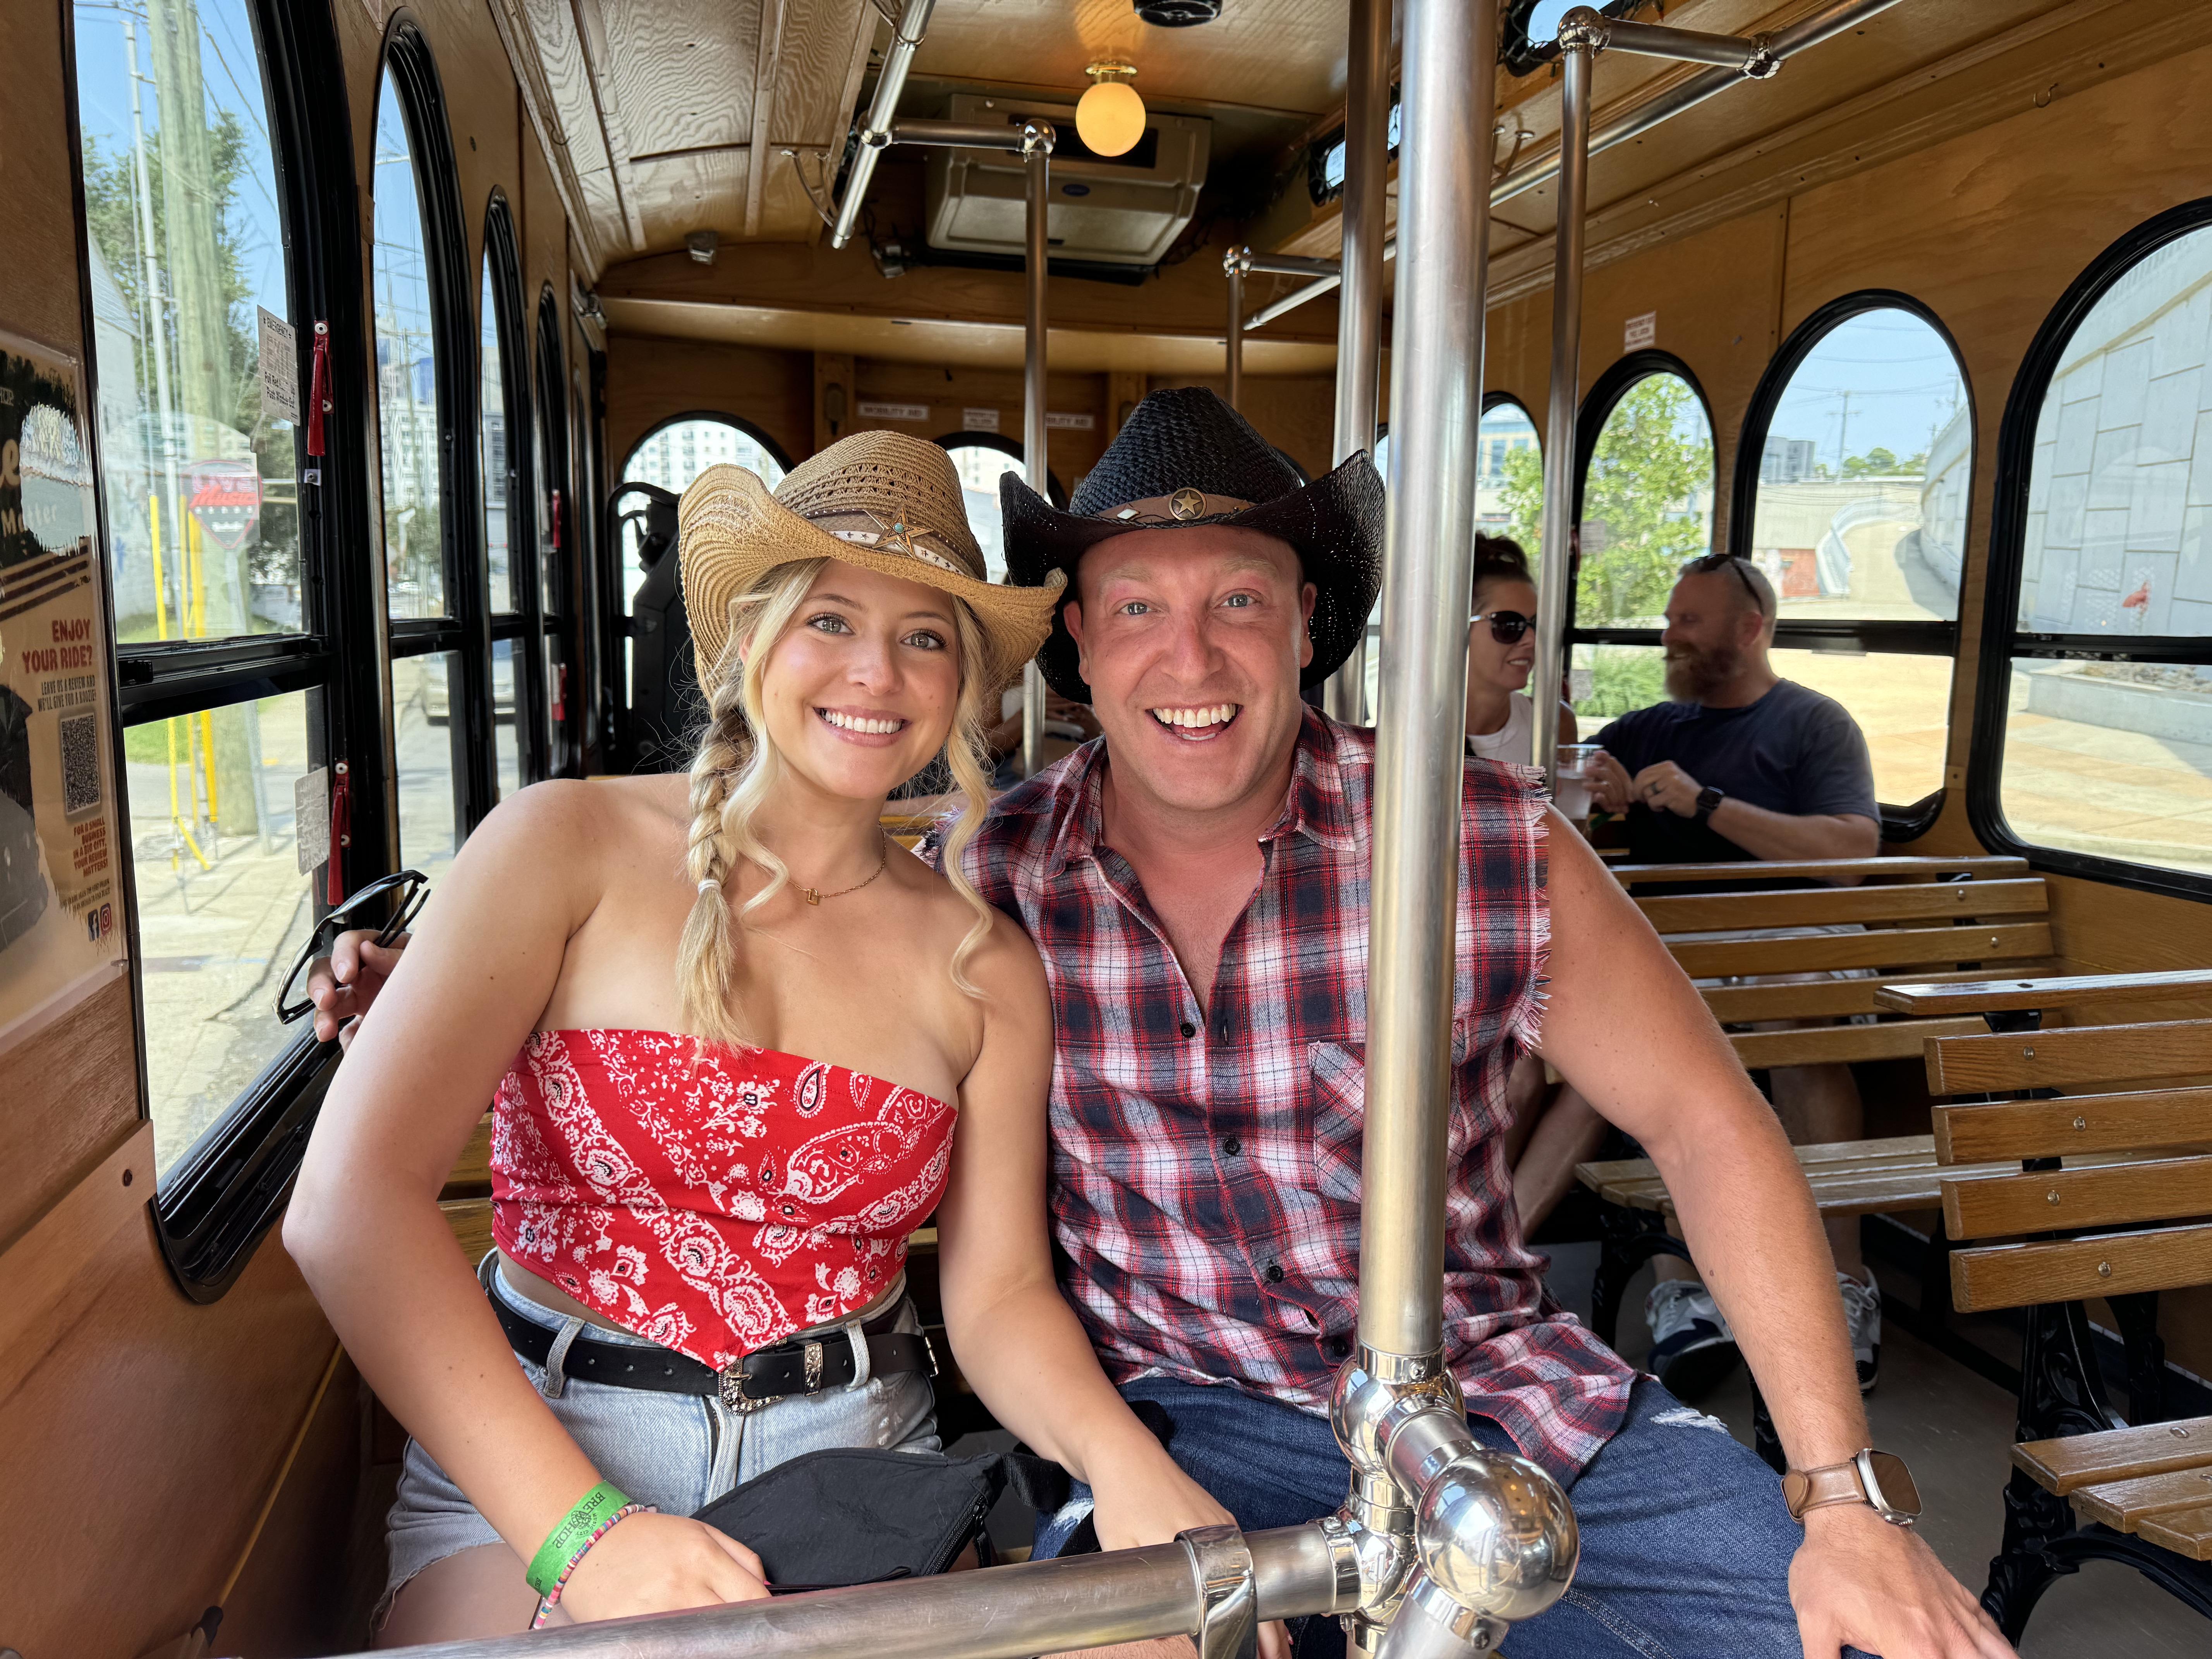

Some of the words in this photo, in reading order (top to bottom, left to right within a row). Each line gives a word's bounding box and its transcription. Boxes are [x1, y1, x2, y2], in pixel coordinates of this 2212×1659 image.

[266, 333, 290, 378] EXIT
[276, 391, 288, 406] Window
[52, 618, 90, 642] ENJOY
[22, 648, 58, 673] YOUR
[60, 645, 93, 670] RIDE?
[41, 680, 56, 695] LEAVE
[57, 679, 63, 692] US
[68, 676, 85, 690] REVIEW
[86, 675, 95, 687] AND
[38, 697, 53, 712] WE'LL
[53, 694, 64, 709] GIVE
[65, 693, 74, 706] YOU
[75, 692, 78, 704] A
[74, 824, 84, 837] FOR
[89, 815, 105, 830] SMALL
[82, 826, 106, 845] BUSINESS
[79, 846, 84, 857] A
[74, 856, 88, 870] YOUR
[589, 1513, 598, 1530] MUSIC
